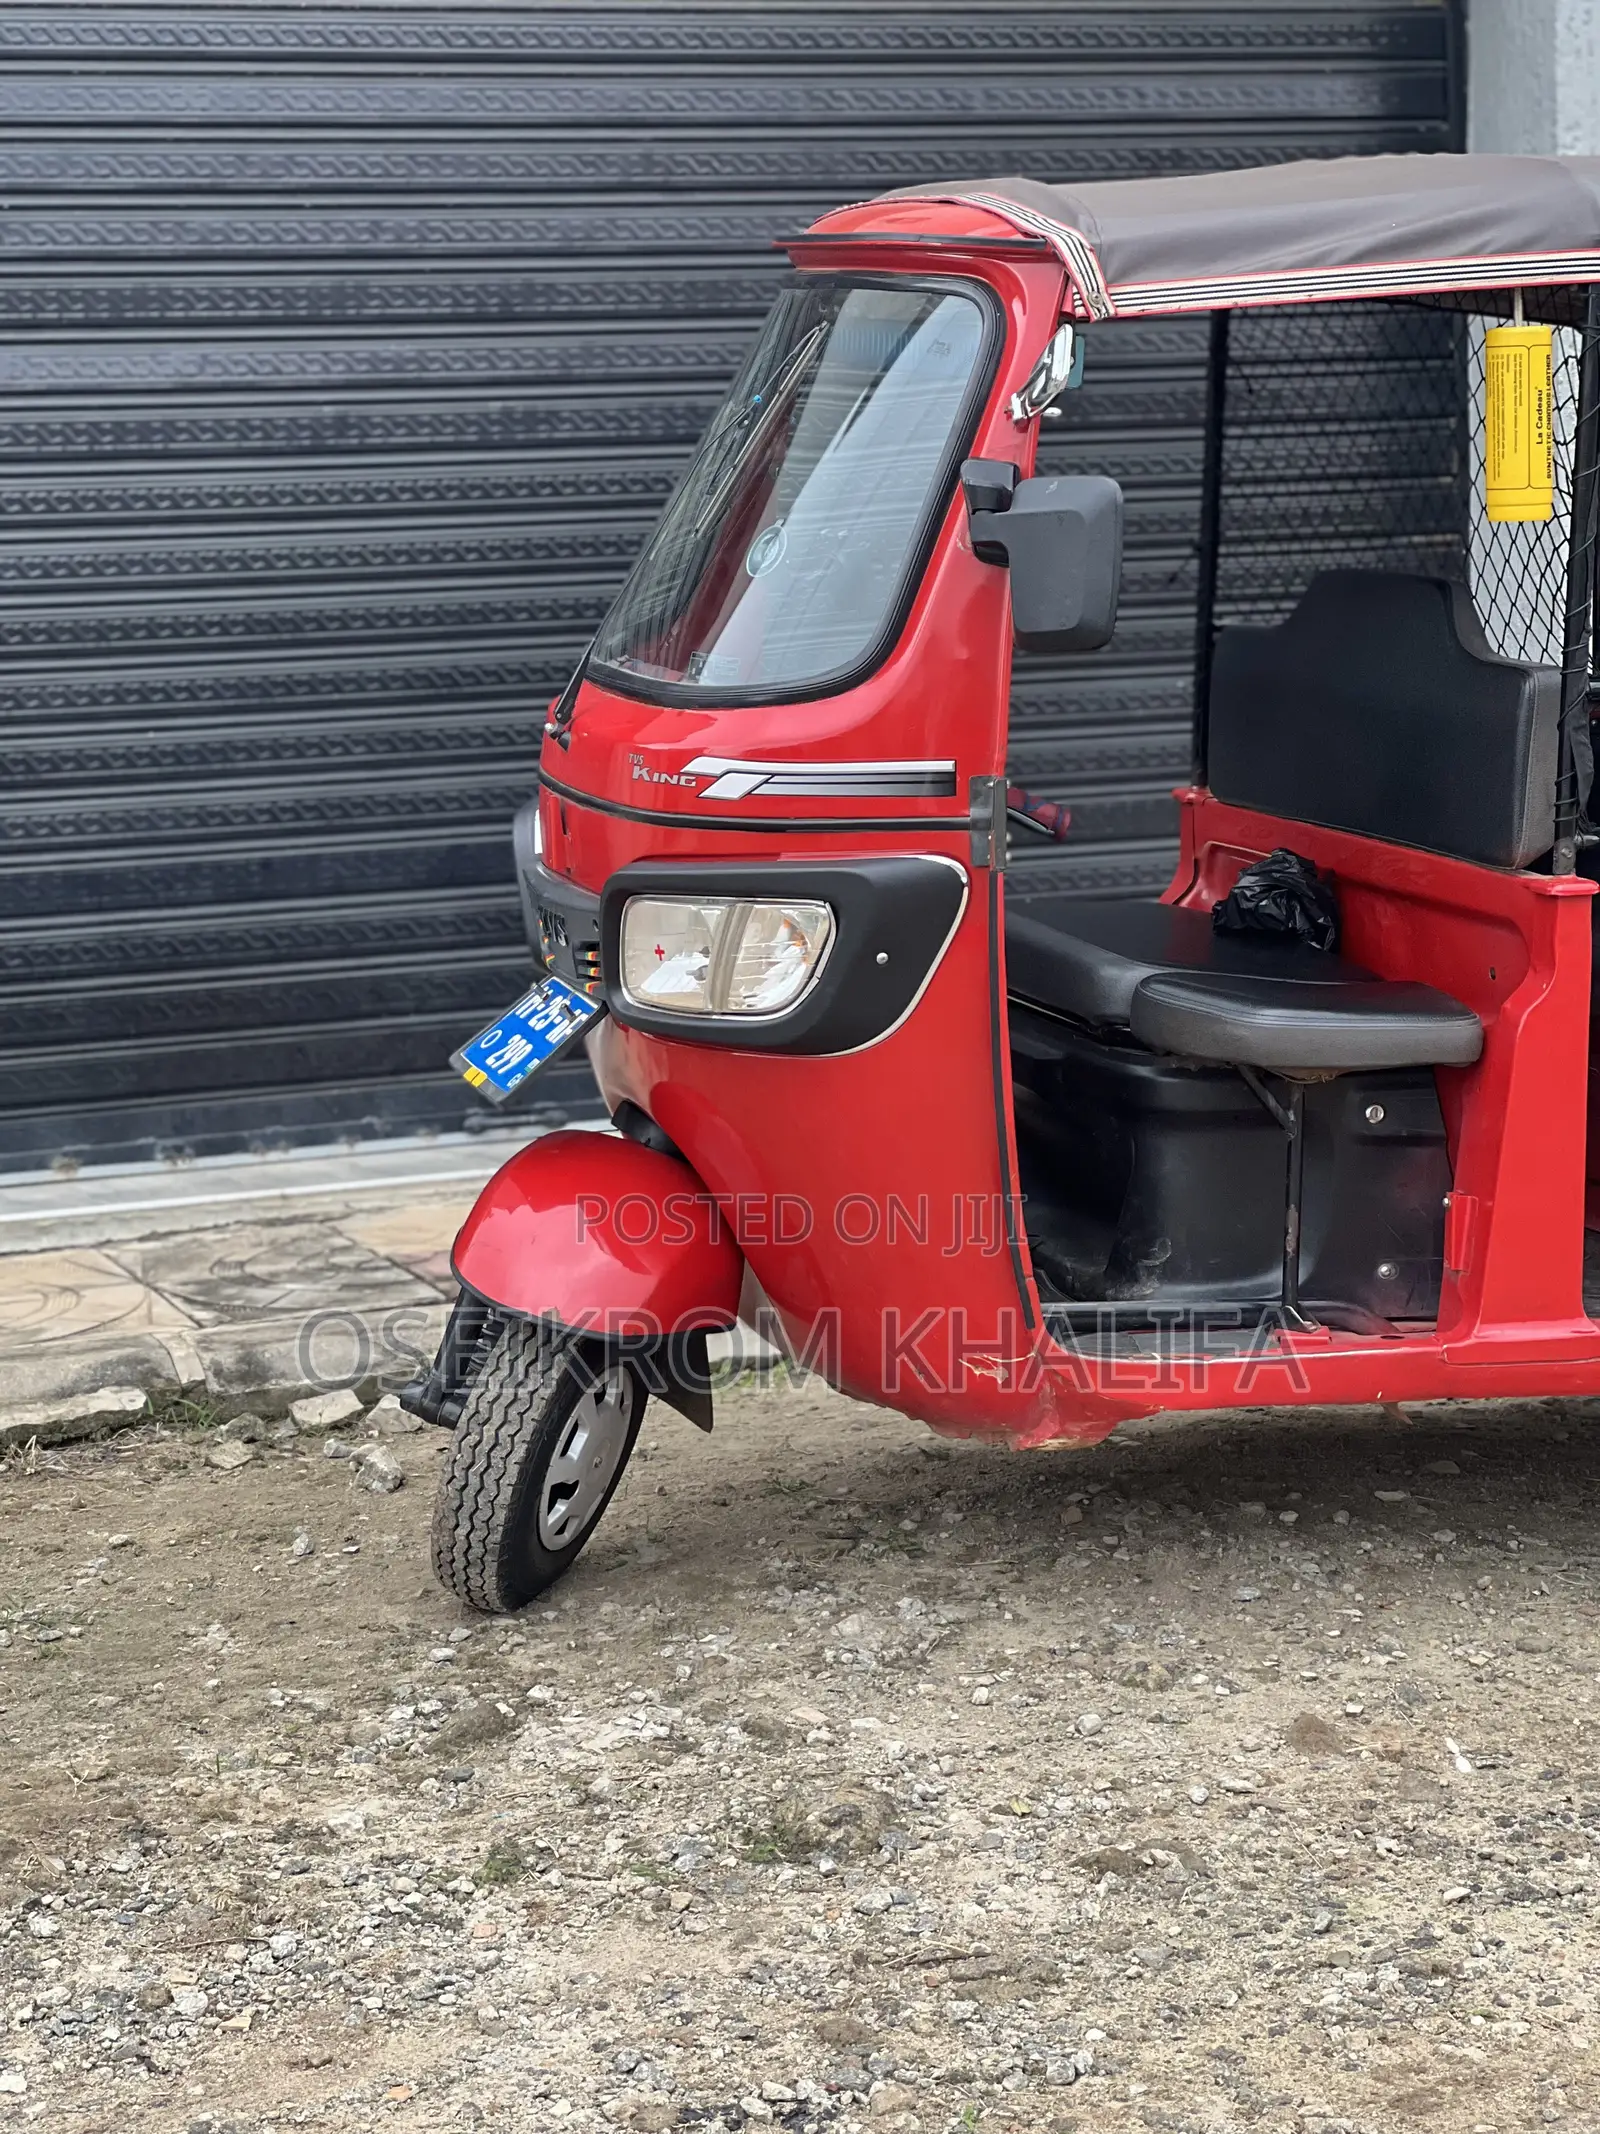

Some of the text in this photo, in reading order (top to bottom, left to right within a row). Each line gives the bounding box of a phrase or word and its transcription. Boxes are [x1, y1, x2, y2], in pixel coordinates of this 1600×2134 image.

[1536, 432, 1543, 445] La
[628, 753, 644, 765] TVS
[485, 1034, 534, 1075] 299
